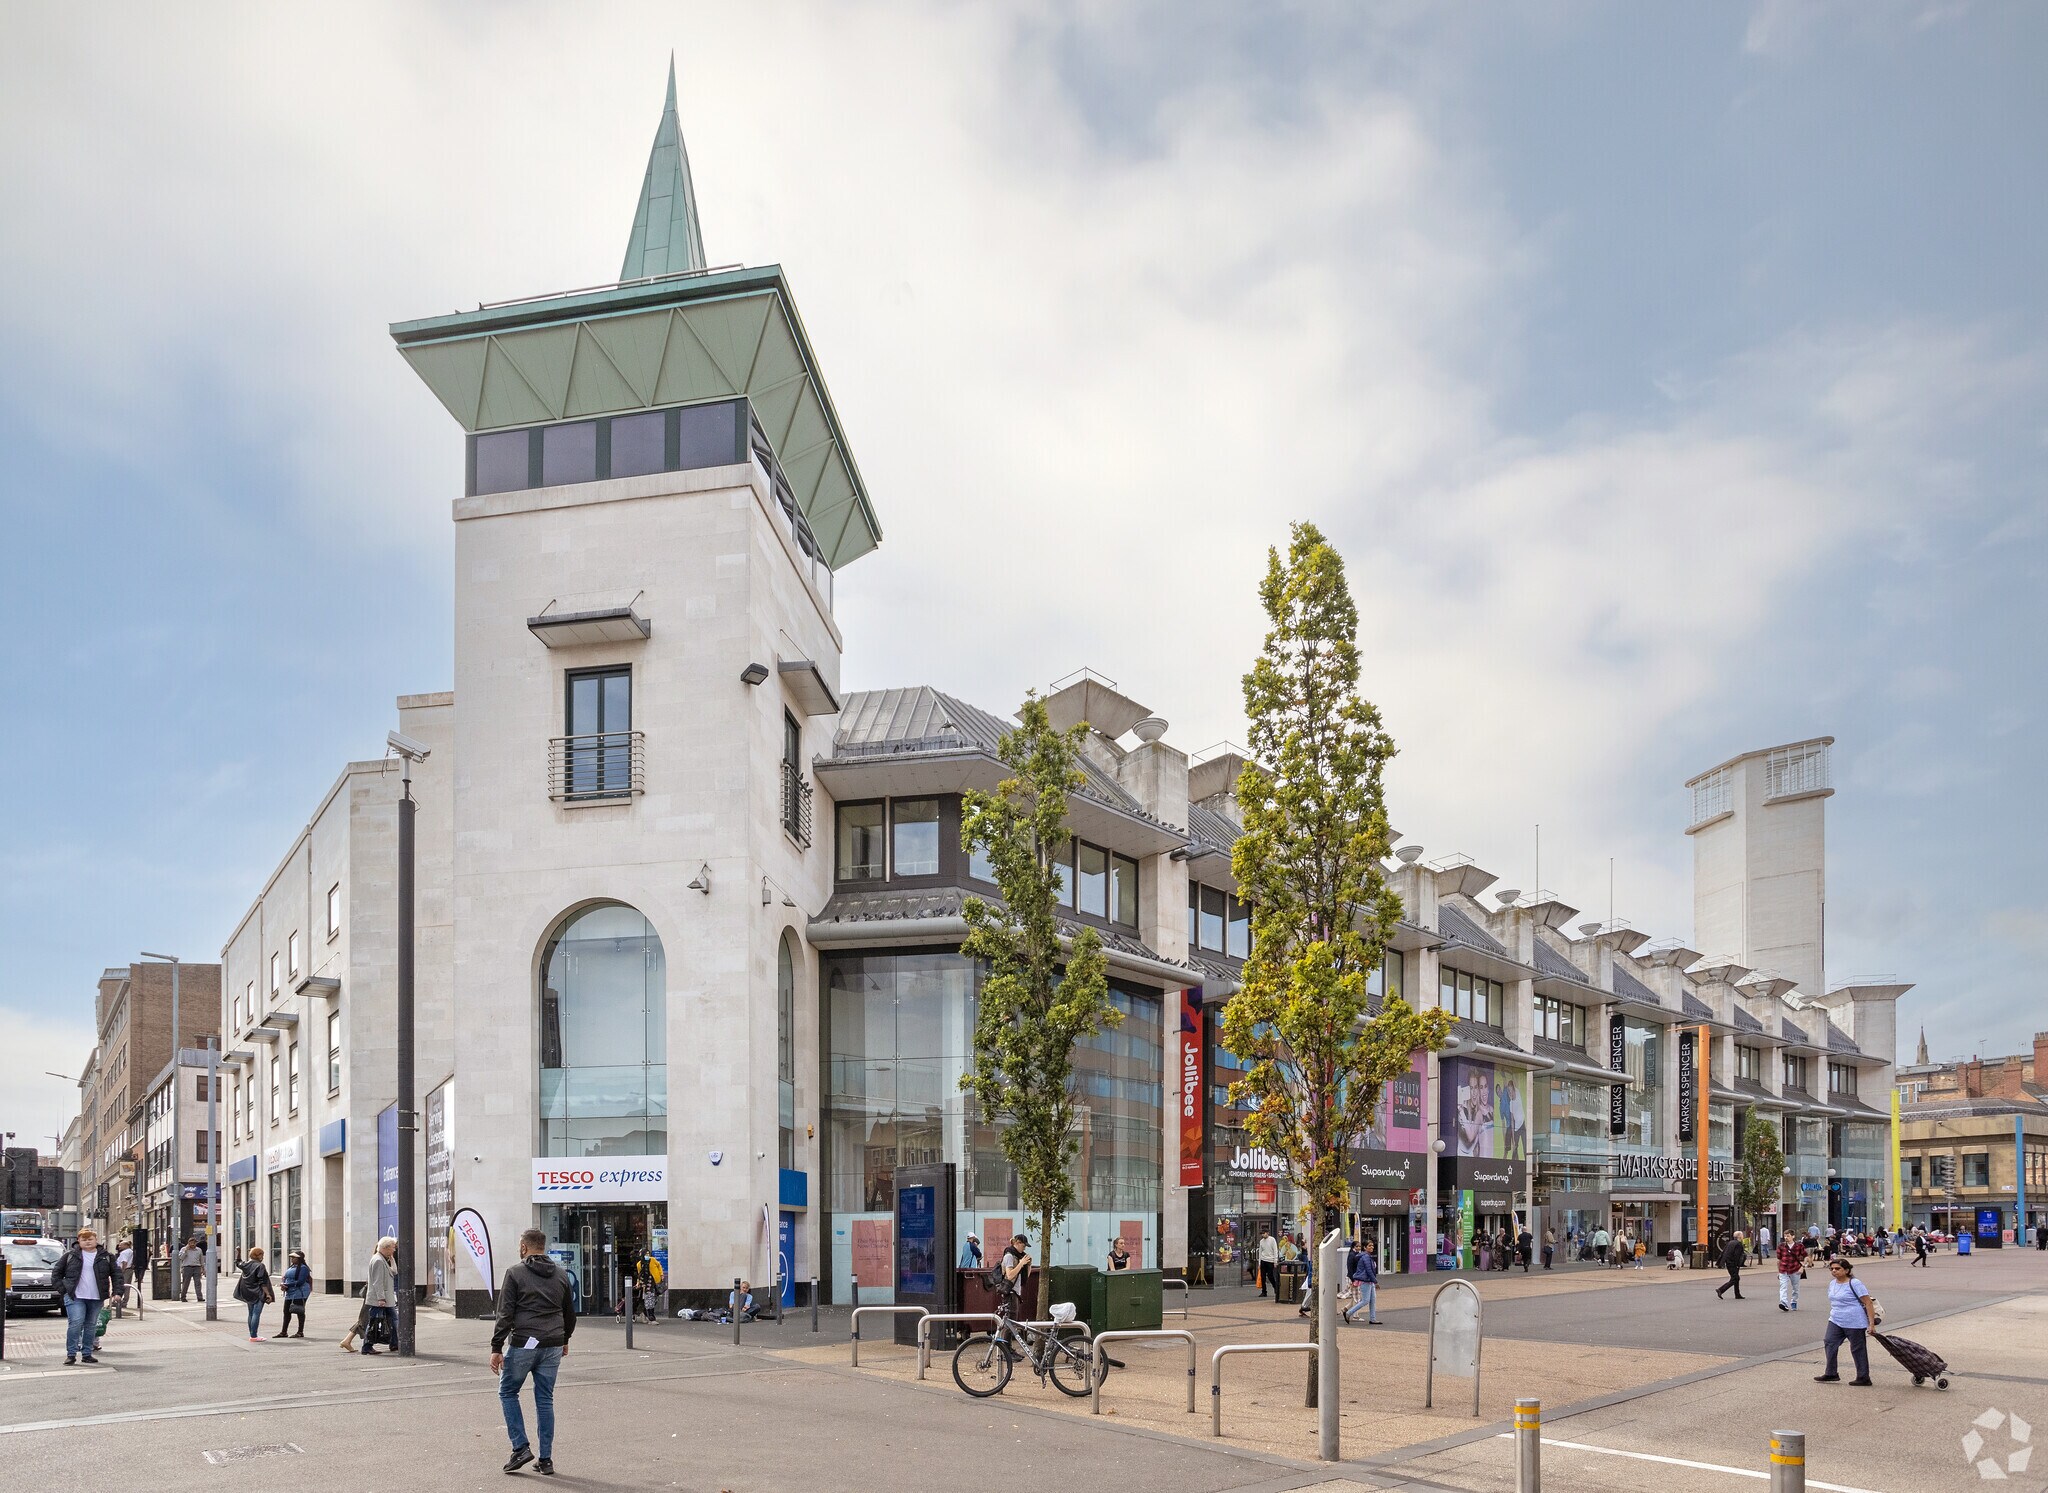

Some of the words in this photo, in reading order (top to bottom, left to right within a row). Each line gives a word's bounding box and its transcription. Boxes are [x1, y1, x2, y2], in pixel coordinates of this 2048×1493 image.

[1681, 1043, 1690, 1090] SPENCER
[1184, 1042, 1199, 1117] Jollibee
[1394, 1081, 1419, 1096] BEAUTY
[1394, 1095, 1419, 1107] STUDIO
[1681, 1091, 1690, 1101] &
[1612, 1087, 1622, 1124] MARKS
[1681, 1102, 1690, 1132] MARKS
[1230, 1145, 1287, 1171] Jollibee
[1361, 1164, 1406, 1180] Superdrug
[1619, 1154, 1665, 1179] MARKS
[1667, 1157, 1676, 1179] &
[1678, 1158, 1726, 1181] SPECER
[537, 1170, 594, 1185] TESCO
[599, 1169, 662, 1187] express
[1473, 1170, 1509, 1184] Superdrug
[1370, 1198, 1401, 1207] superdrug.com
[1480, 1199, 1506, 1208] superdrug.com
[462, 1220, 485, 1256] TESCO
